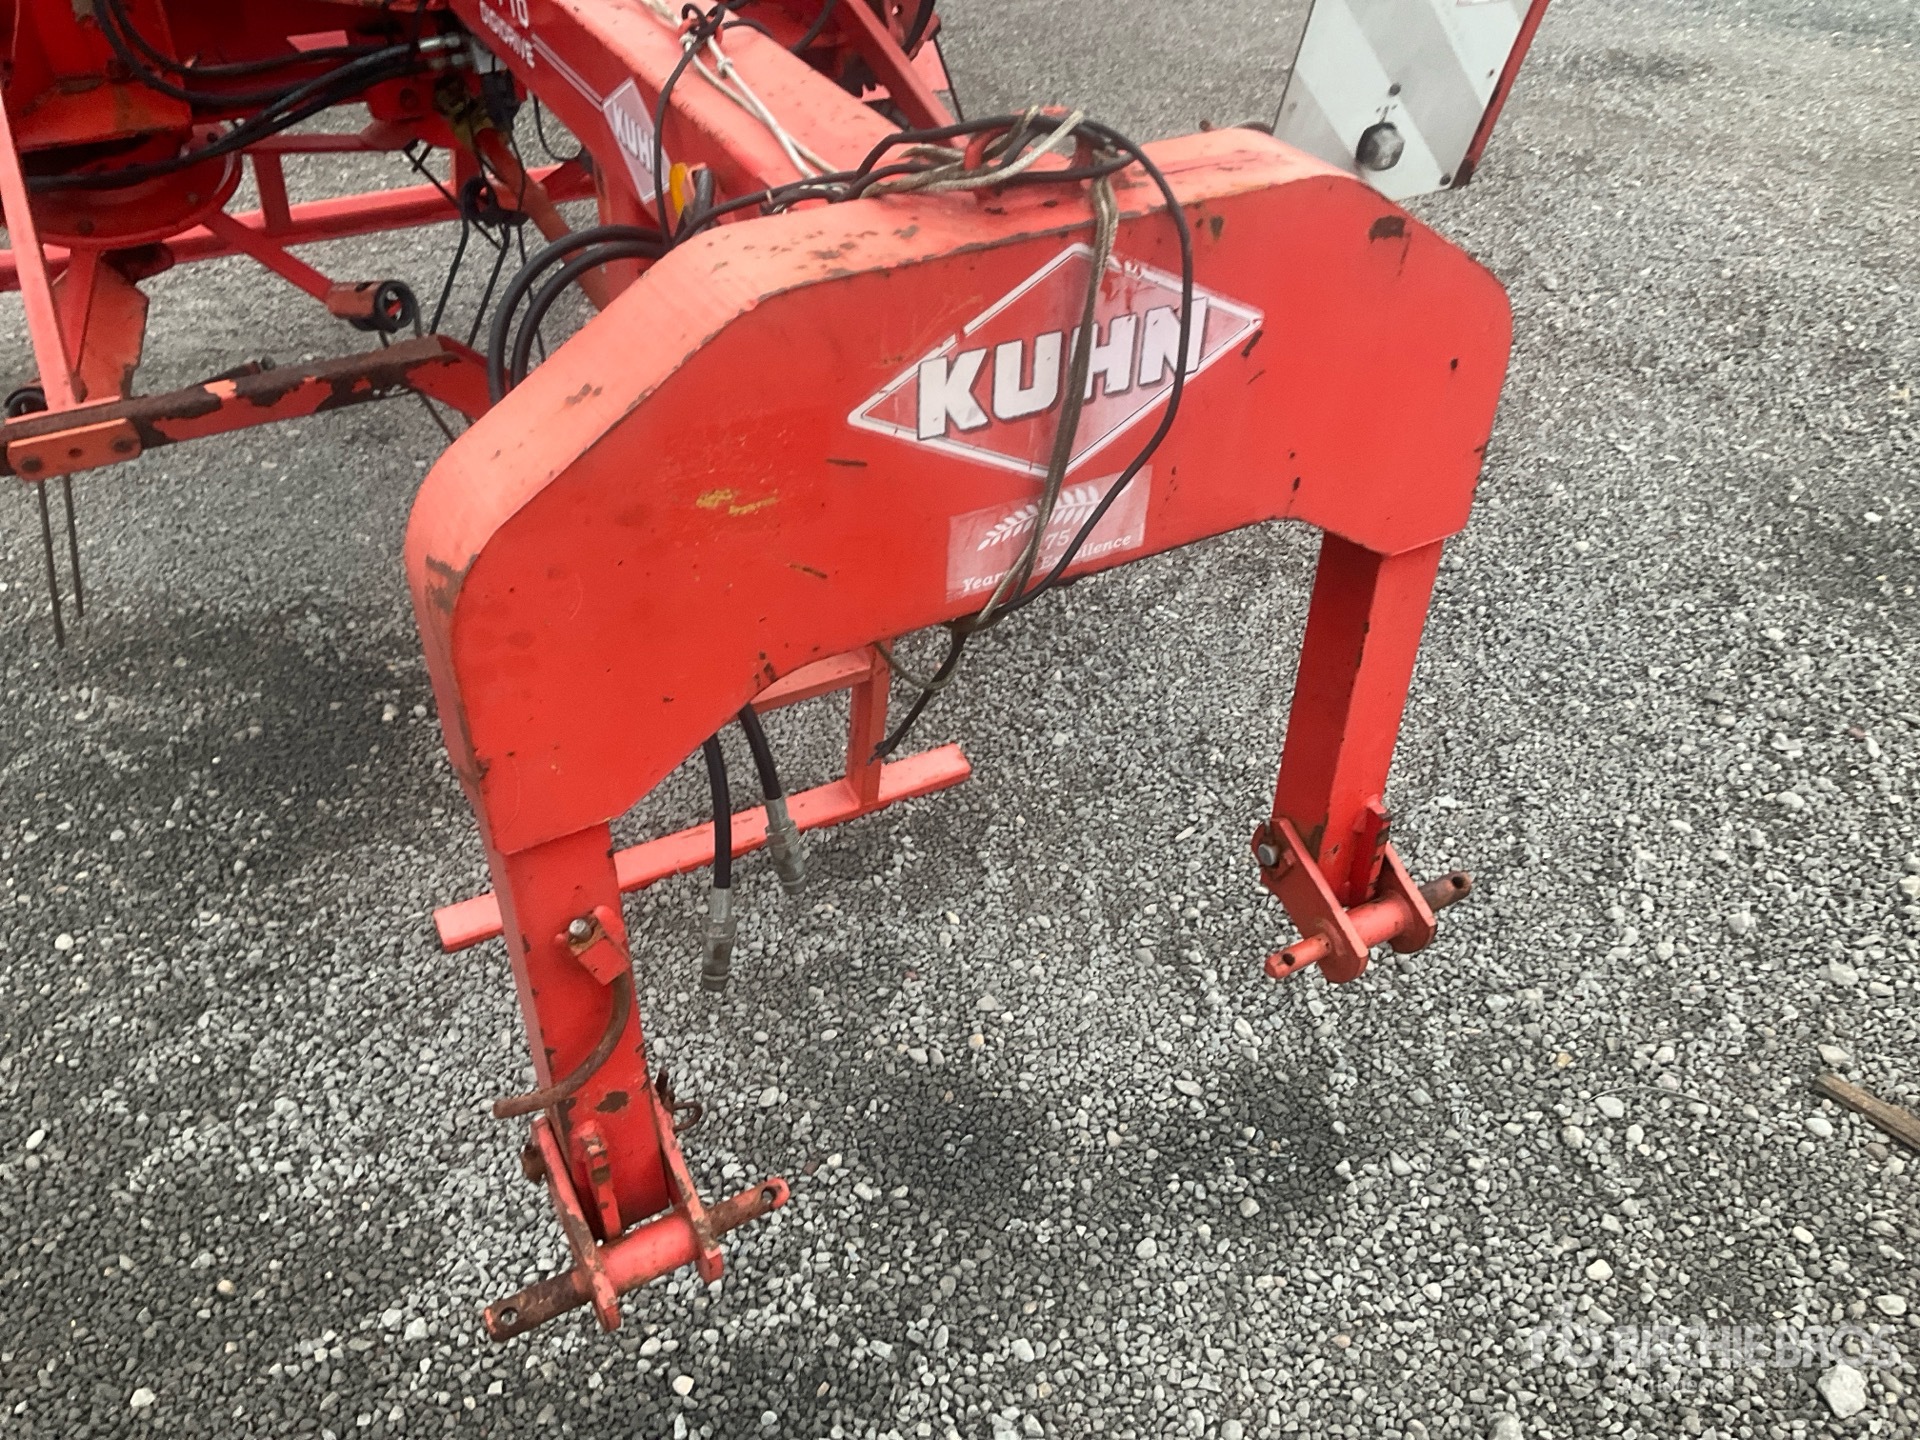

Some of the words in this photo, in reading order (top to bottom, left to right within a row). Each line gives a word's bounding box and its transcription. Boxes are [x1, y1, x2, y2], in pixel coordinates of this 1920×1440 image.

[612, 100, 657, 176] KUH
[916, 296, 1208, 441] KUHN
[1045, 530, 1070, 551] 75
